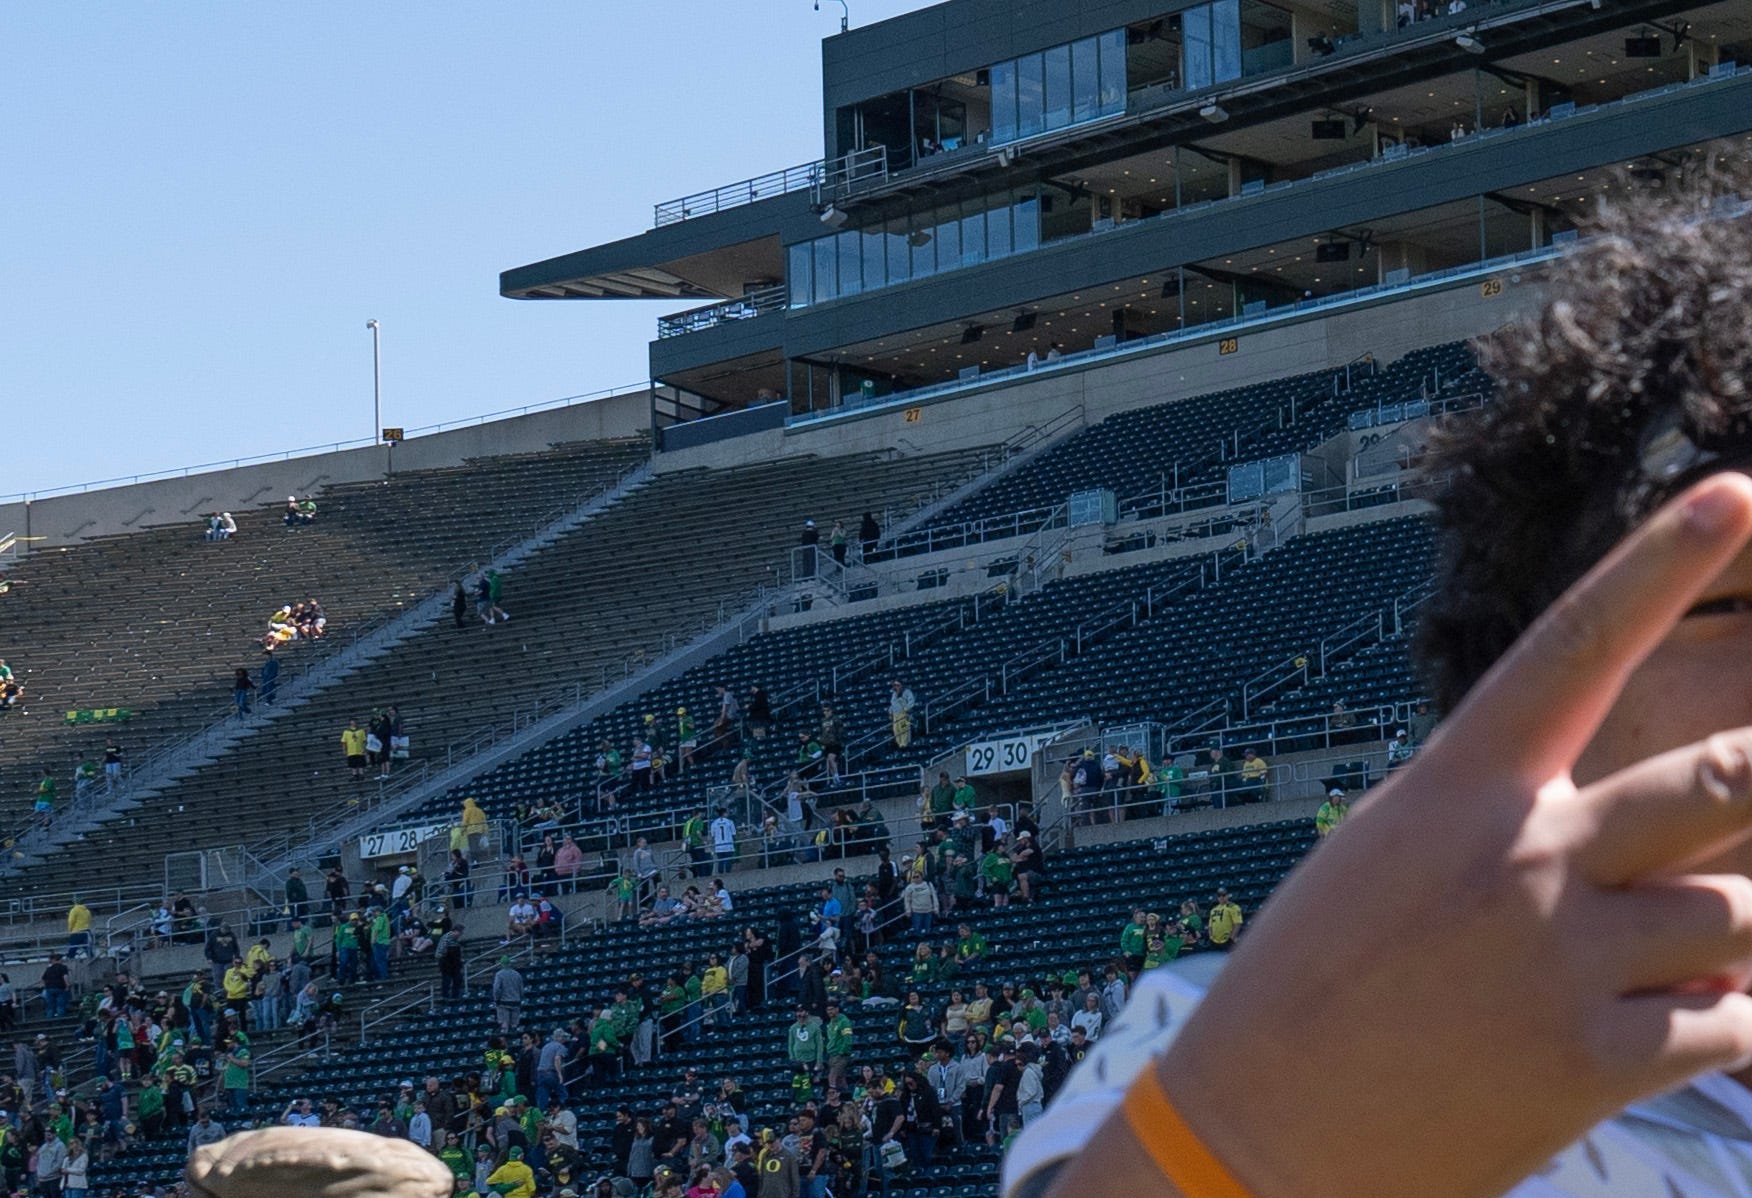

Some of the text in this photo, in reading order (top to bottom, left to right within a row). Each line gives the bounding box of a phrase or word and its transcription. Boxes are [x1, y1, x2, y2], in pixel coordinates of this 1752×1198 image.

[1484, 282, 1501, 296] 29
[1221, 340, 1236, 354] 28
[907, 410, 920, 422] 27
[385, 430, 401, 439] 26
[972, 747, 994, 771] 29
[1004, 742, 1027, 765] 30
[719, 826, 725, 840] 1
[368, 835, 384, 855] 27
[400, 831, 417, 851] 28
[766, 1159, 781, 1173] O
